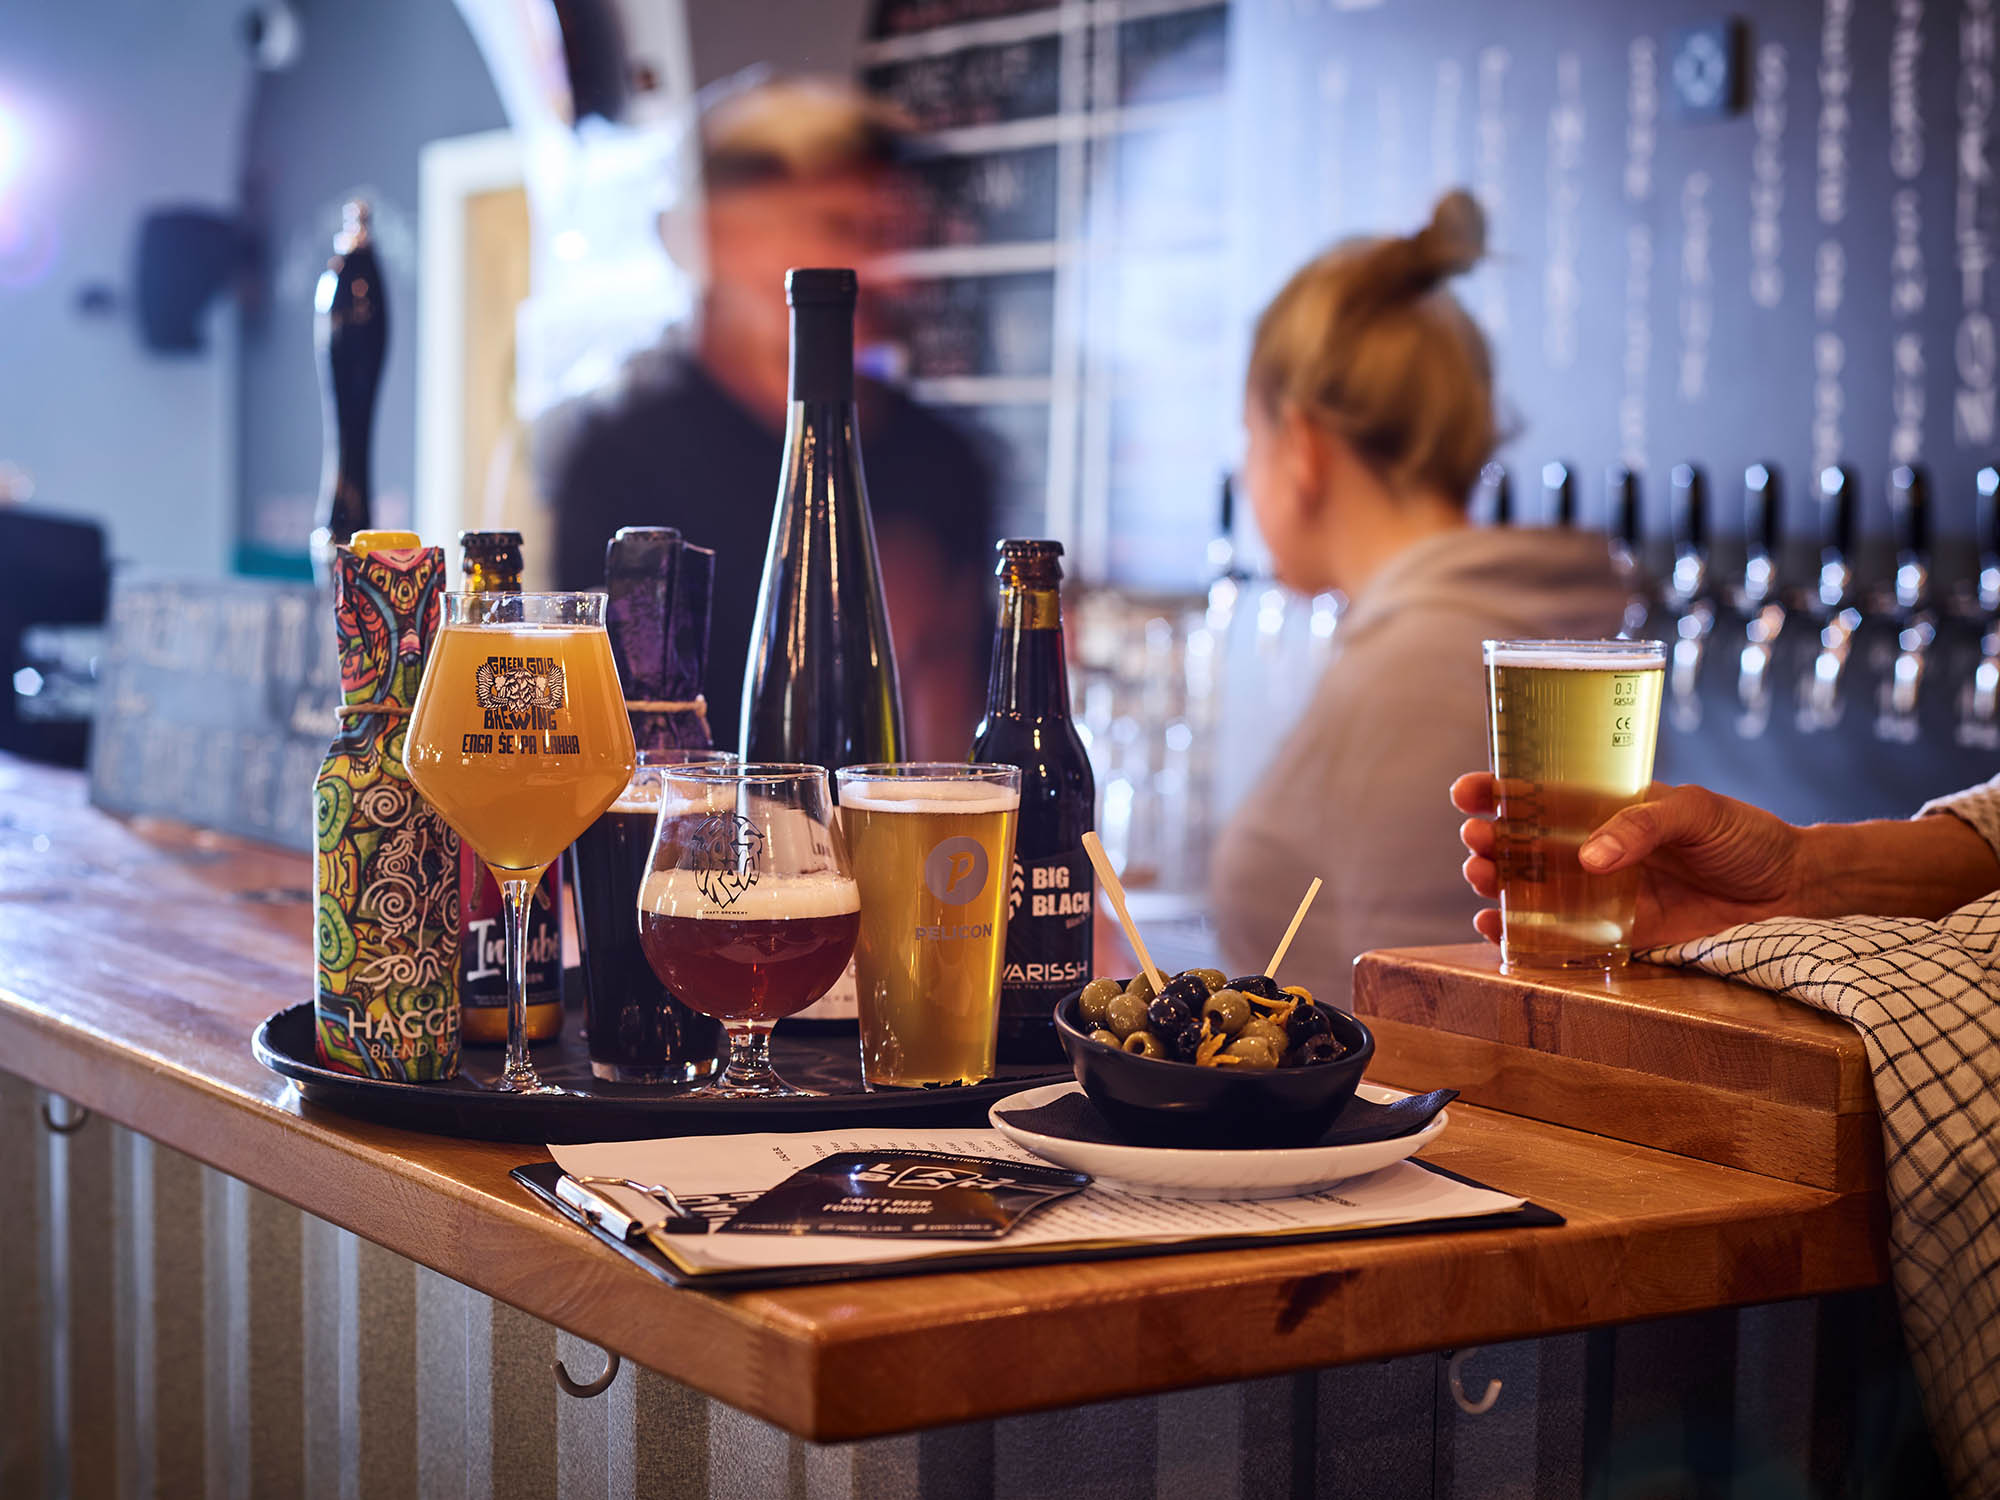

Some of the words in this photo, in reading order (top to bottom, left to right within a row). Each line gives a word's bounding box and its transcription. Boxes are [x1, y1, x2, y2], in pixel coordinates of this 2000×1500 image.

[487, 657, 523, 675] GREEN
[484, 707, 557, 730] BREWING
[462, 734, 493, 754] ENGA
[520, 735, 537, 755] PA
[1032, 866, 1070, 890] BIG
[1032, 891, 1091, 917] BLACK
[915, 923, 993, 941] PELICON
[349, 1004, 461, 1039] HAGGE
[370, 1042, 429, 1059] BLEND
